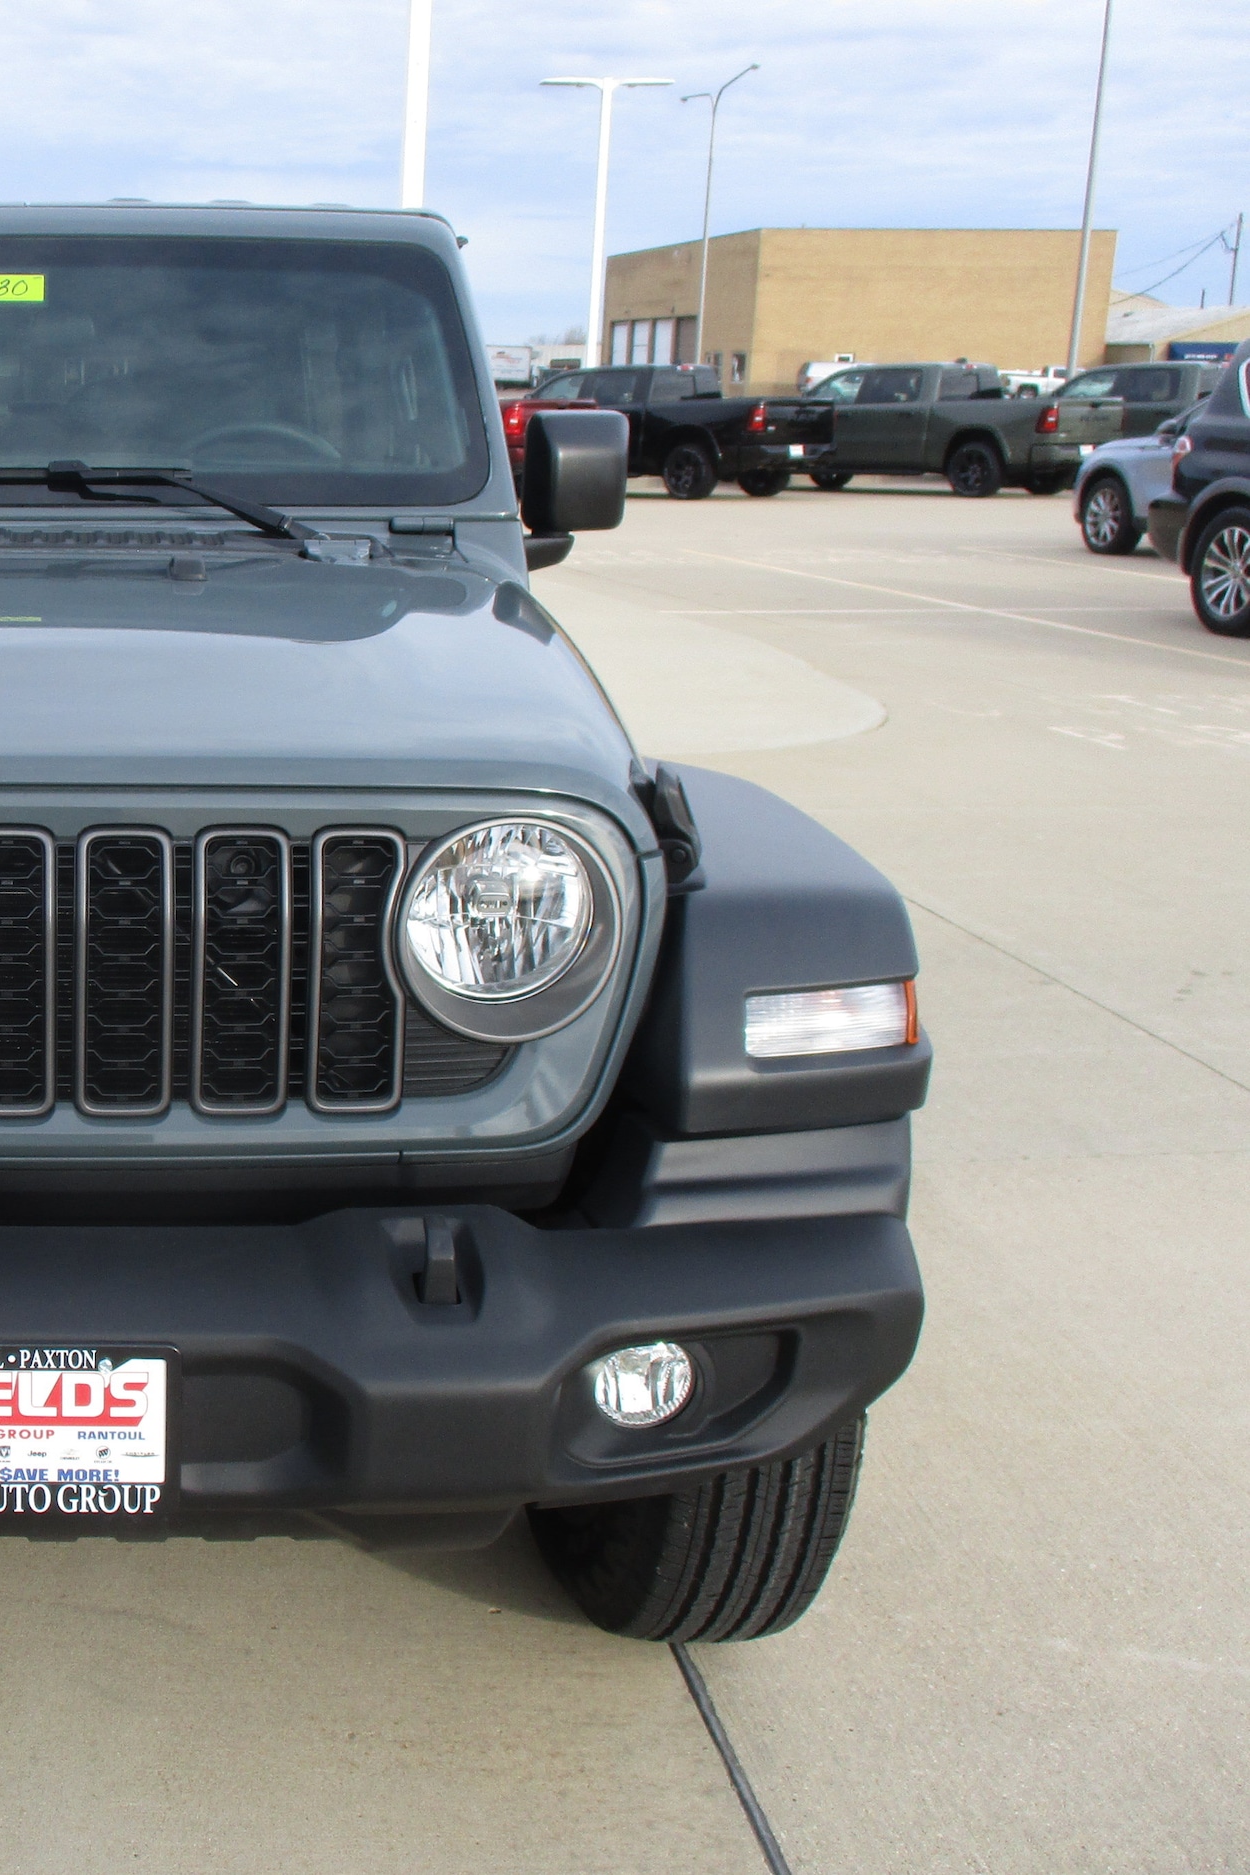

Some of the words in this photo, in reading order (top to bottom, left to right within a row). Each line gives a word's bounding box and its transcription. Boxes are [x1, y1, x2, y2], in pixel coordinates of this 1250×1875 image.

[19, 1349, 97, 1370] PAXTON
[78, 1431, 146, 1441] RANTOUL
[27, 1450, 47, 1458] Jeep
[0, 1467, 48, 1482] $AVE
[57, 1468, 120, 1482] MORE!
[57, 1484, 161, 1514] GROUP
